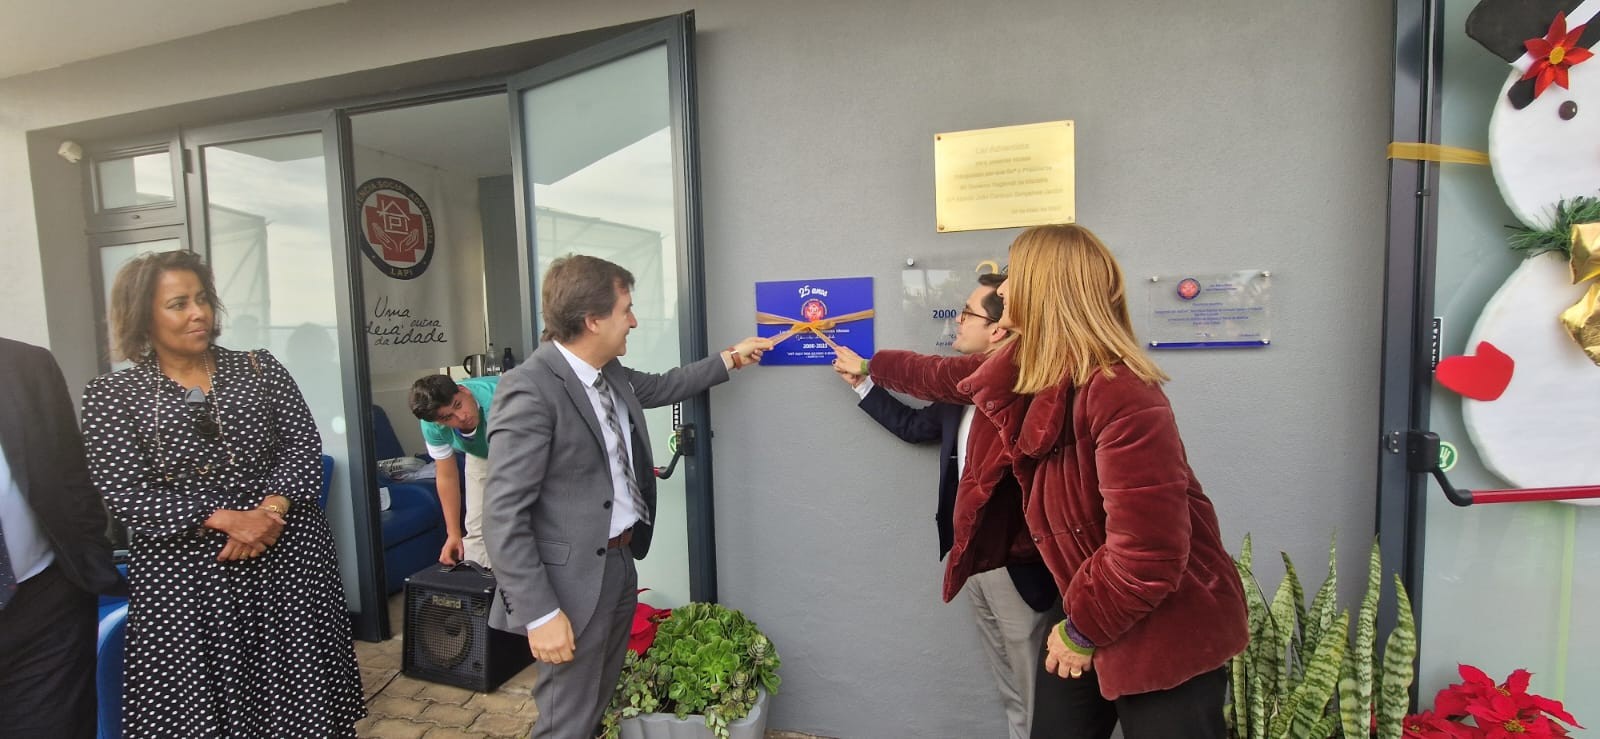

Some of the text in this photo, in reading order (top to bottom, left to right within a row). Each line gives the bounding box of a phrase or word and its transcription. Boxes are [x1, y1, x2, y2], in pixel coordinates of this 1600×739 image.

[798, 285, 811, 298] 25
[374, 295, 411, 318] Uma
[932, 309, 957, 319] 2000
[393, 325, 448, 345] idade
[431, 593, 462, 609] Roland
